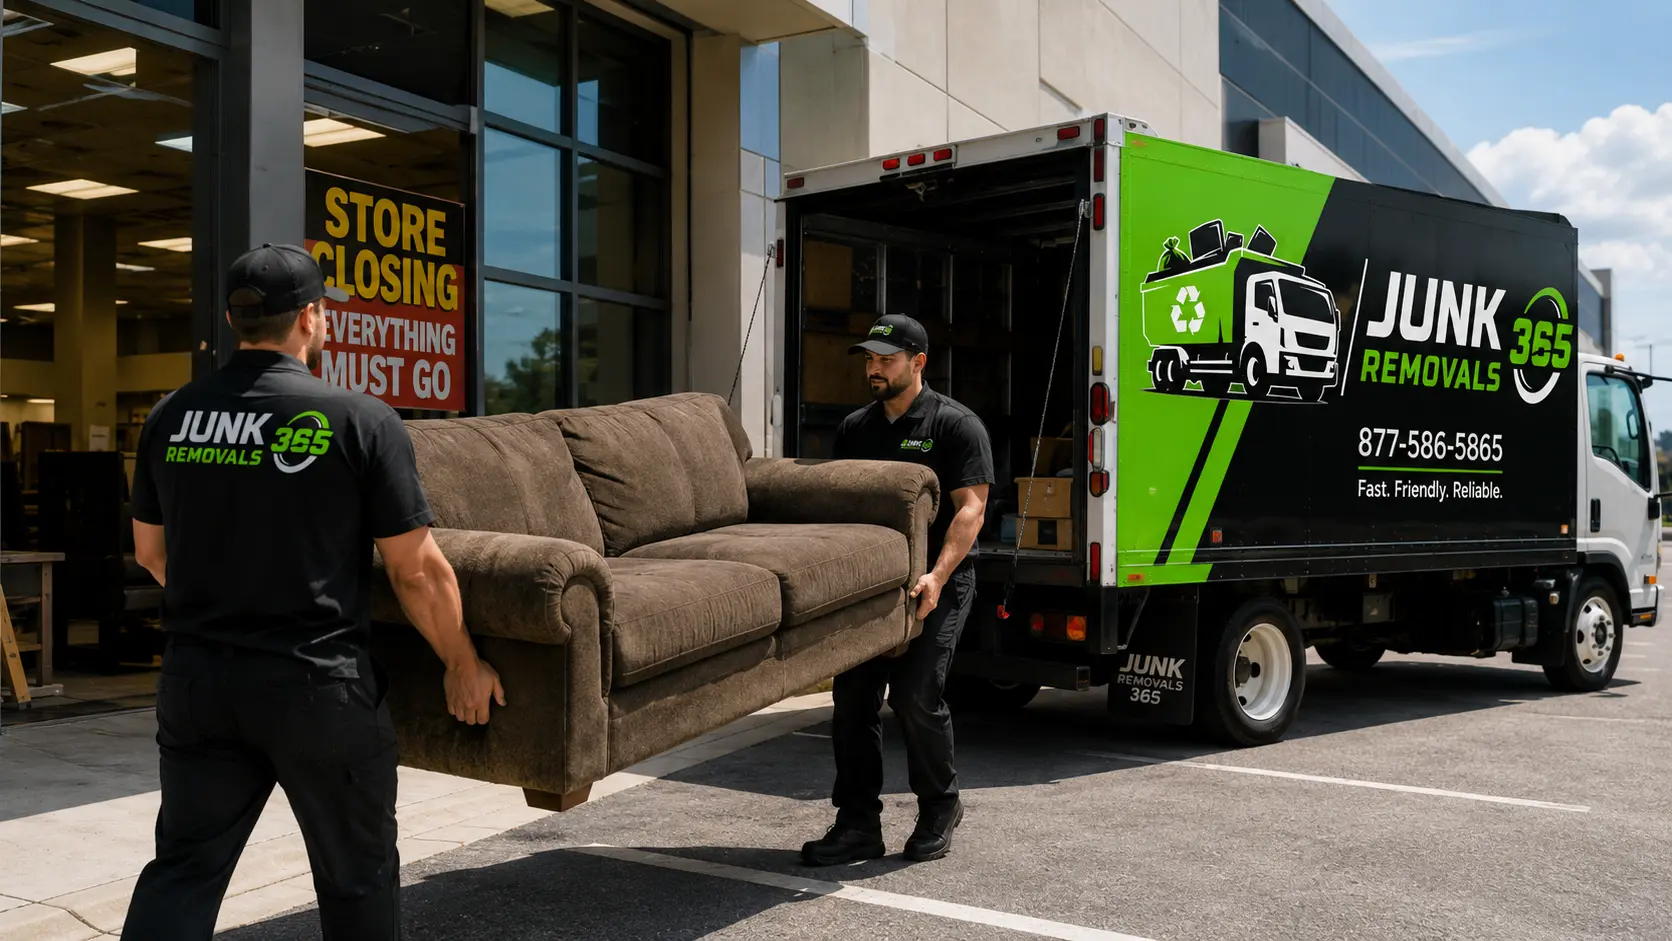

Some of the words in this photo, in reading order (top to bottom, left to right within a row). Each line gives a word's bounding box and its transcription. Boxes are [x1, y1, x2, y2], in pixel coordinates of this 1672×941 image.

[325, 187, 446, 257] STORE
[311, 241, 458, 311] CLOSING
[1366, 271, 1507, 350] JUNK
[1509, 317, 1574, 369] 365
[321, 350, 404, 396] MUST
[413, 359, 451, 400] GO
[1360, 349, 1502, 392] REMOVALS
[169, 410, 273, 445] JUNK
[270, 427, 334, 455] 365
[1358, 427, 1503, 462] 877-586-5865
[165, 446, 263, 466] REMOVALS
[1358, 479, 1390, 497] Fast.
[1394, 480, 1449, 503] Friendly.
[1453, 481, 1503, 499] Reliable.
[1117, 673, 1184, 691] REMOVALS
[1119, 653, 1186, 679] JUNK
[1130, 687, 1161, 705] 365
